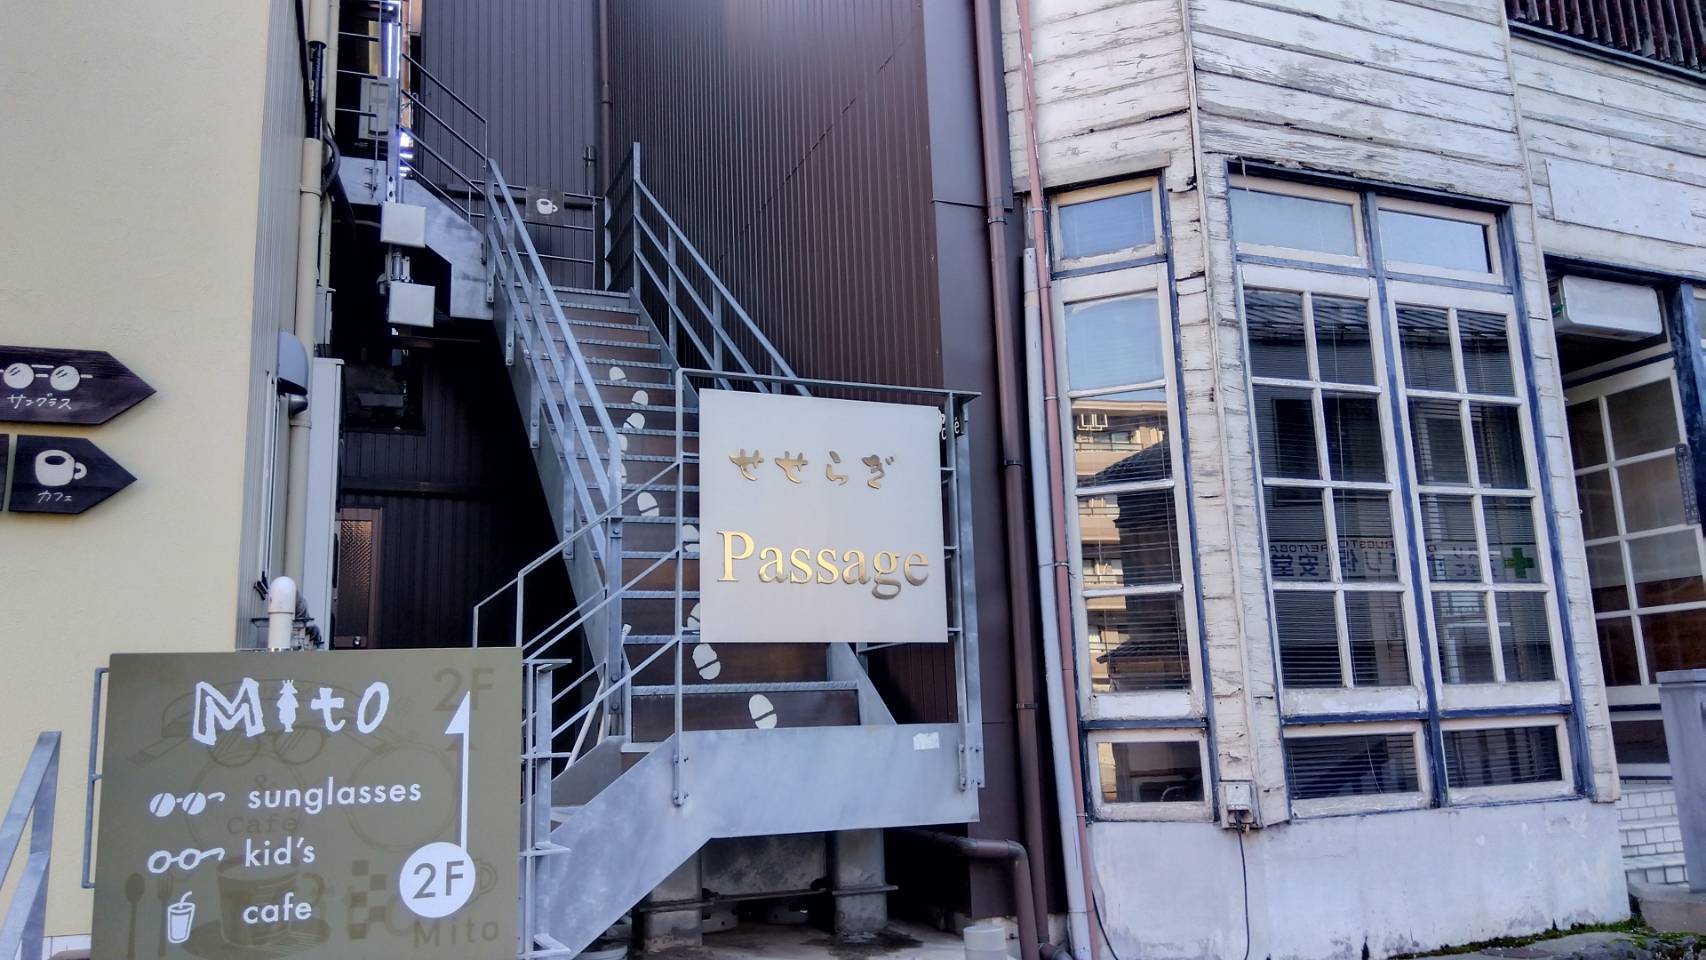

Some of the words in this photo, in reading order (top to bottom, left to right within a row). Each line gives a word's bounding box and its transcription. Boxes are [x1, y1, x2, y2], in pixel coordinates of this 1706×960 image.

[6, 392, 73, 410] サングラス
[729, 448, 895, 489] せせらぎ
[37, 489, 73, 504] カフェ
[717, 530, 929, 600] Passage
[432, 667, 495, 713] 2F
[247, 776, 422, 815] sunglasses
[244, 836, 316, 868] kid's
[412, 860, 465, 899] 2F
[243, 892, 313, 925] cafe
[413, 917, 500, 949] Mito
